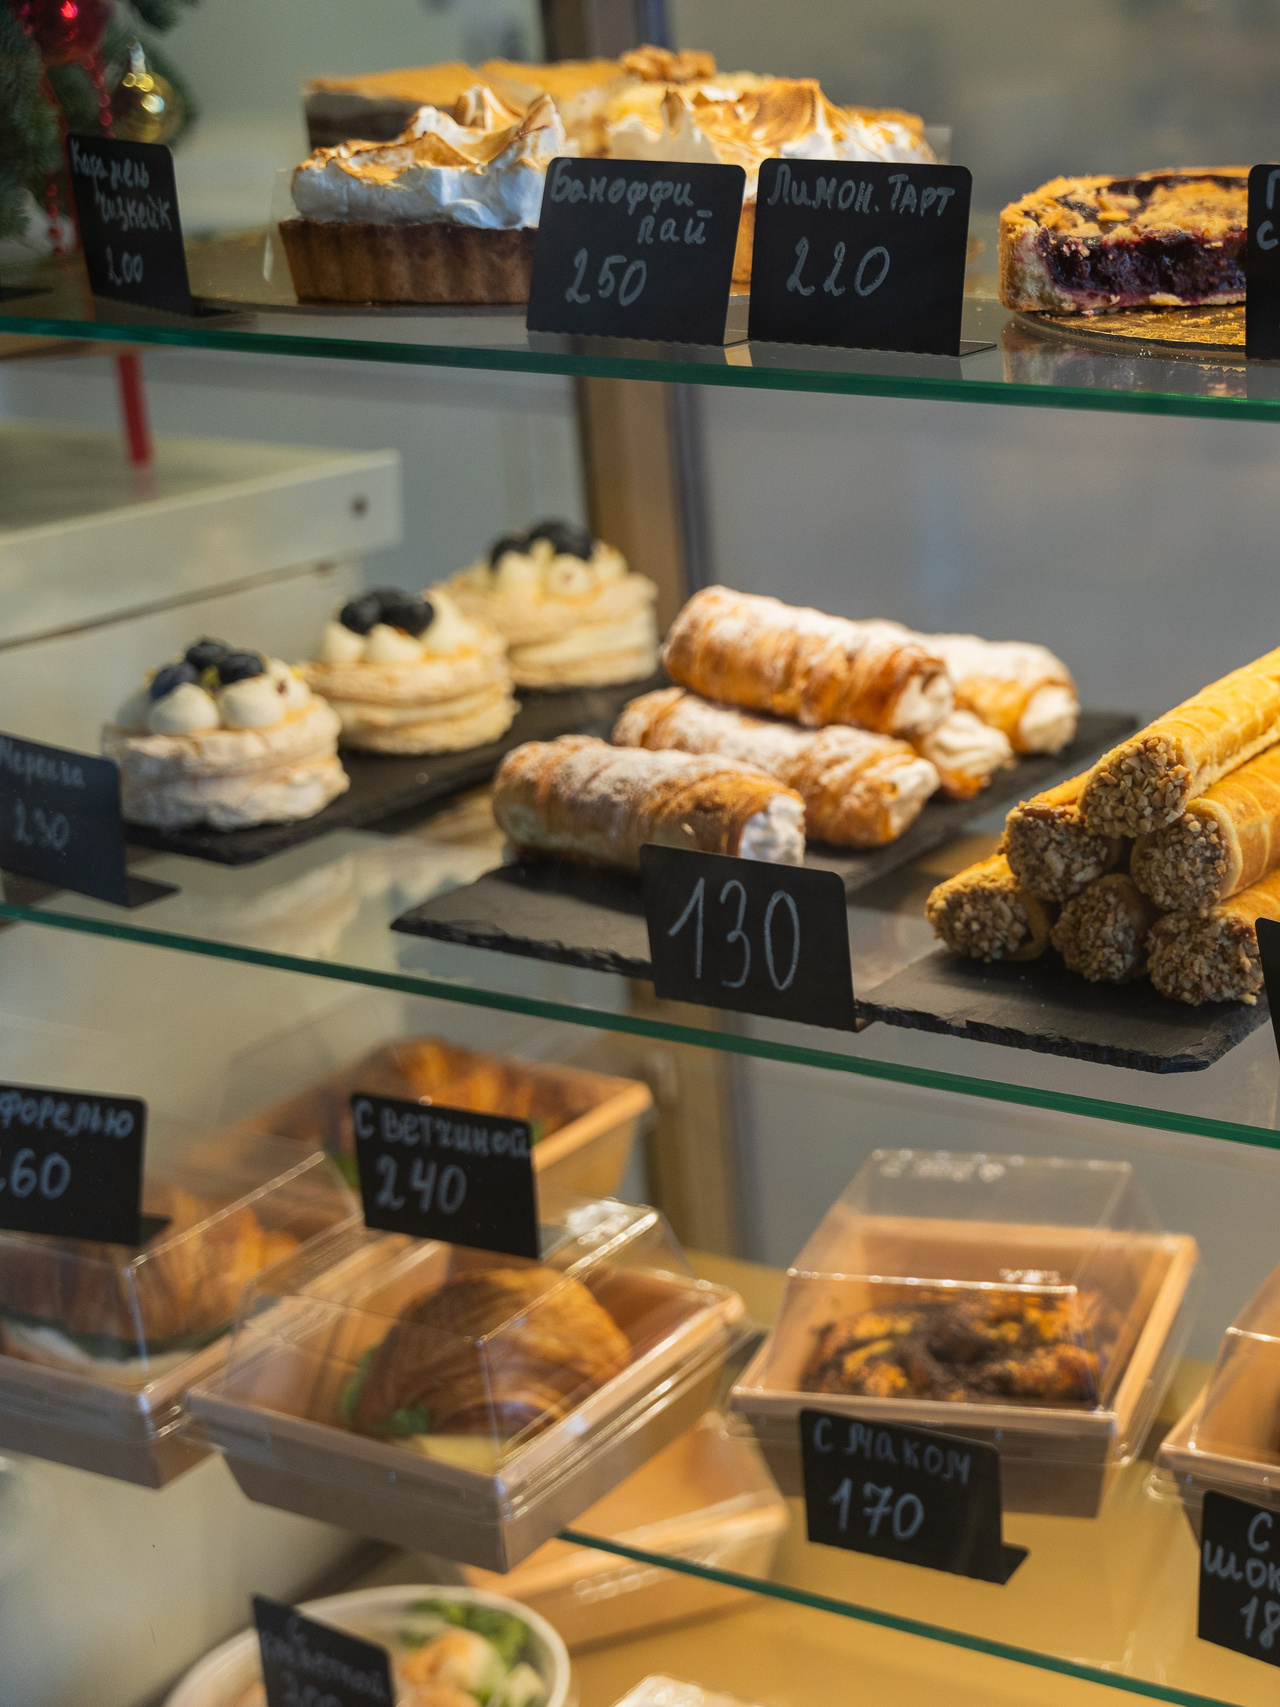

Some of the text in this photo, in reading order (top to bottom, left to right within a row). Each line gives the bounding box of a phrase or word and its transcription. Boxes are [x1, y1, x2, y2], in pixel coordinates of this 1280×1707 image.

[550, 159, 694, 216] Баноффи
[637, 210, 713, 244] пай
[566, 247, 647, 306] 250
[786, 236, 890, 296] 220
[668, 877, 800, 991] 130
[0, 1148, 71, 1198] 60
[374, 1155, 467, 1214] 240
[829, 1478, 925, 1541] 170
